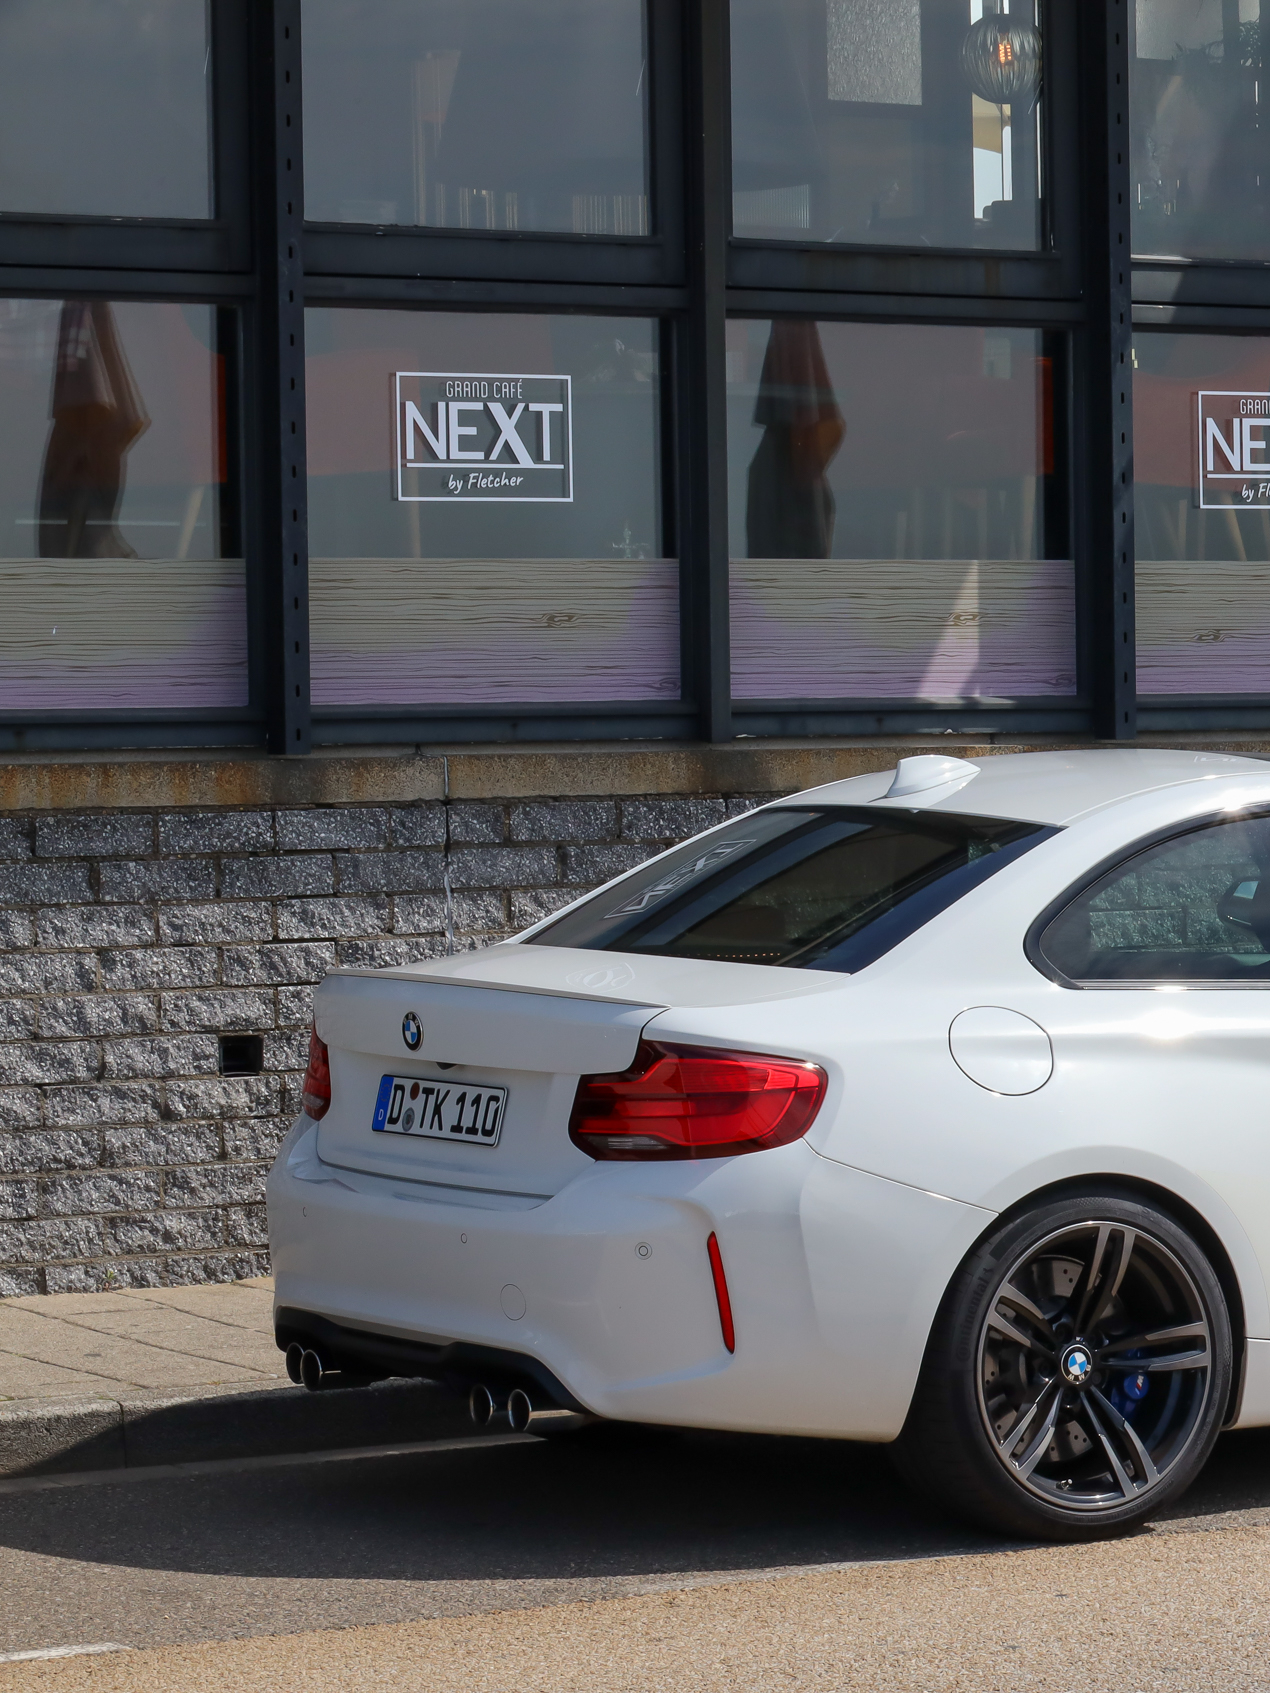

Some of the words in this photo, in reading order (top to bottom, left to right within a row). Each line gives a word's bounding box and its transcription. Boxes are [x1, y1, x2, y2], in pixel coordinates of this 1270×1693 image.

[446, 381, 488, 398] GRAND
[493, 379, 523, 399] CAFÉ
[405, 401, 563, 464] NEXT
[448, 475, 463, 494] by
[467, 472, 524, 490] Fletcher
[1242, 484, 1254, 502] by
[377, 1108, 384, 1121] D
[387, 1083, 405, 1126] D
[419, 1087, 450, 1132] TK
[450, 1091, 501, 1138] 110
